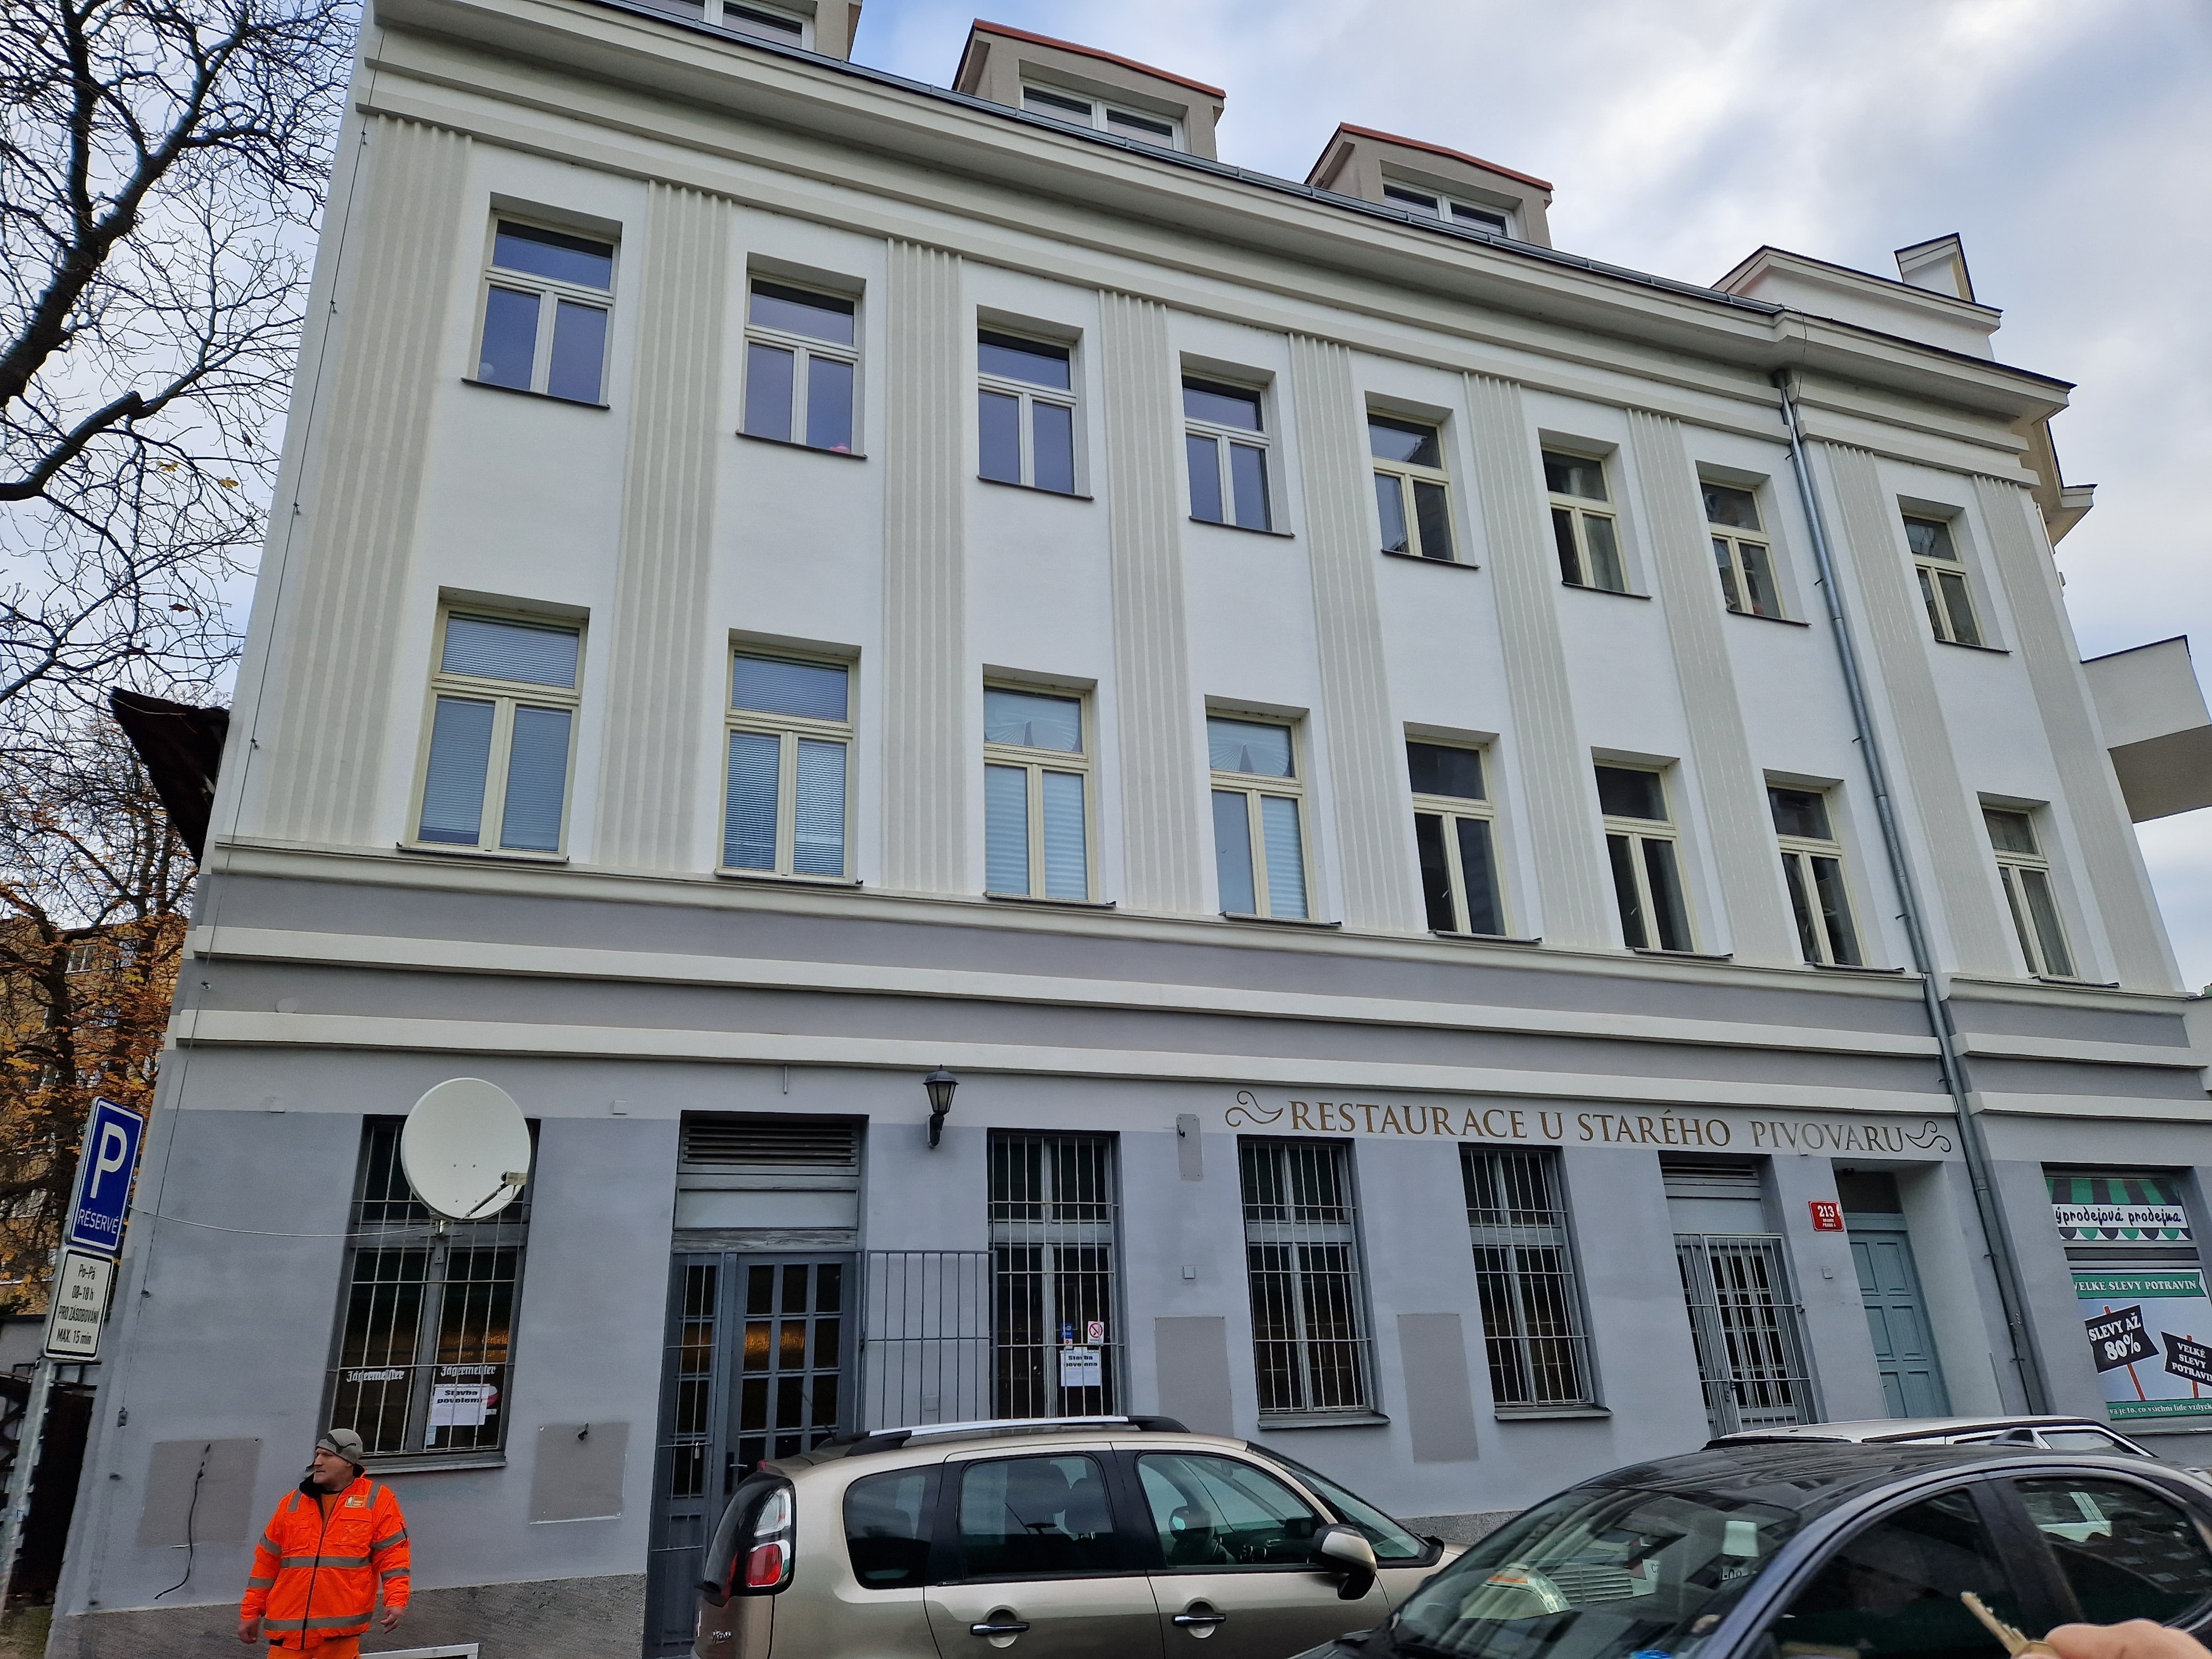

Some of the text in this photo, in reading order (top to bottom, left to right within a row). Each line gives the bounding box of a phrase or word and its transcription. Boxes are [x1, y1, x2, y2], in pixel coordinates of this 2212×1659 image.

[1288, 1101, 1902, 1152] RESTAURACE U STARÉHO PIVOVARU
[90, 1122, 127, 1199] P
[1817, 1205, 1835, 1218] 213
[2128, 1207, 2182, 1226] prodejna
[77, 1207, 119, 1234] RÉSERVÉ
[71, 1285, 94, 1301] 08-18 h
[2109, 1281, 2141, 1291] SLEVY
[2145, 1279, 2196, 1291] POTRAVIN
[58, 1305, 69, 1320] PRO
[2088, 1312, 2141, 1342] SLEVY AŽ
[73, 1330, 81, 1344] 15
[80, 1332, 92, 1344] min
[2104, 1332, 2141, 1361] 80%
[2177, 1342, 2206, 1358] VELKÉ
[2179, 1354, 2207, 1369] SLEVY
[441, 1365, 496, 1377] Jägermeiter
